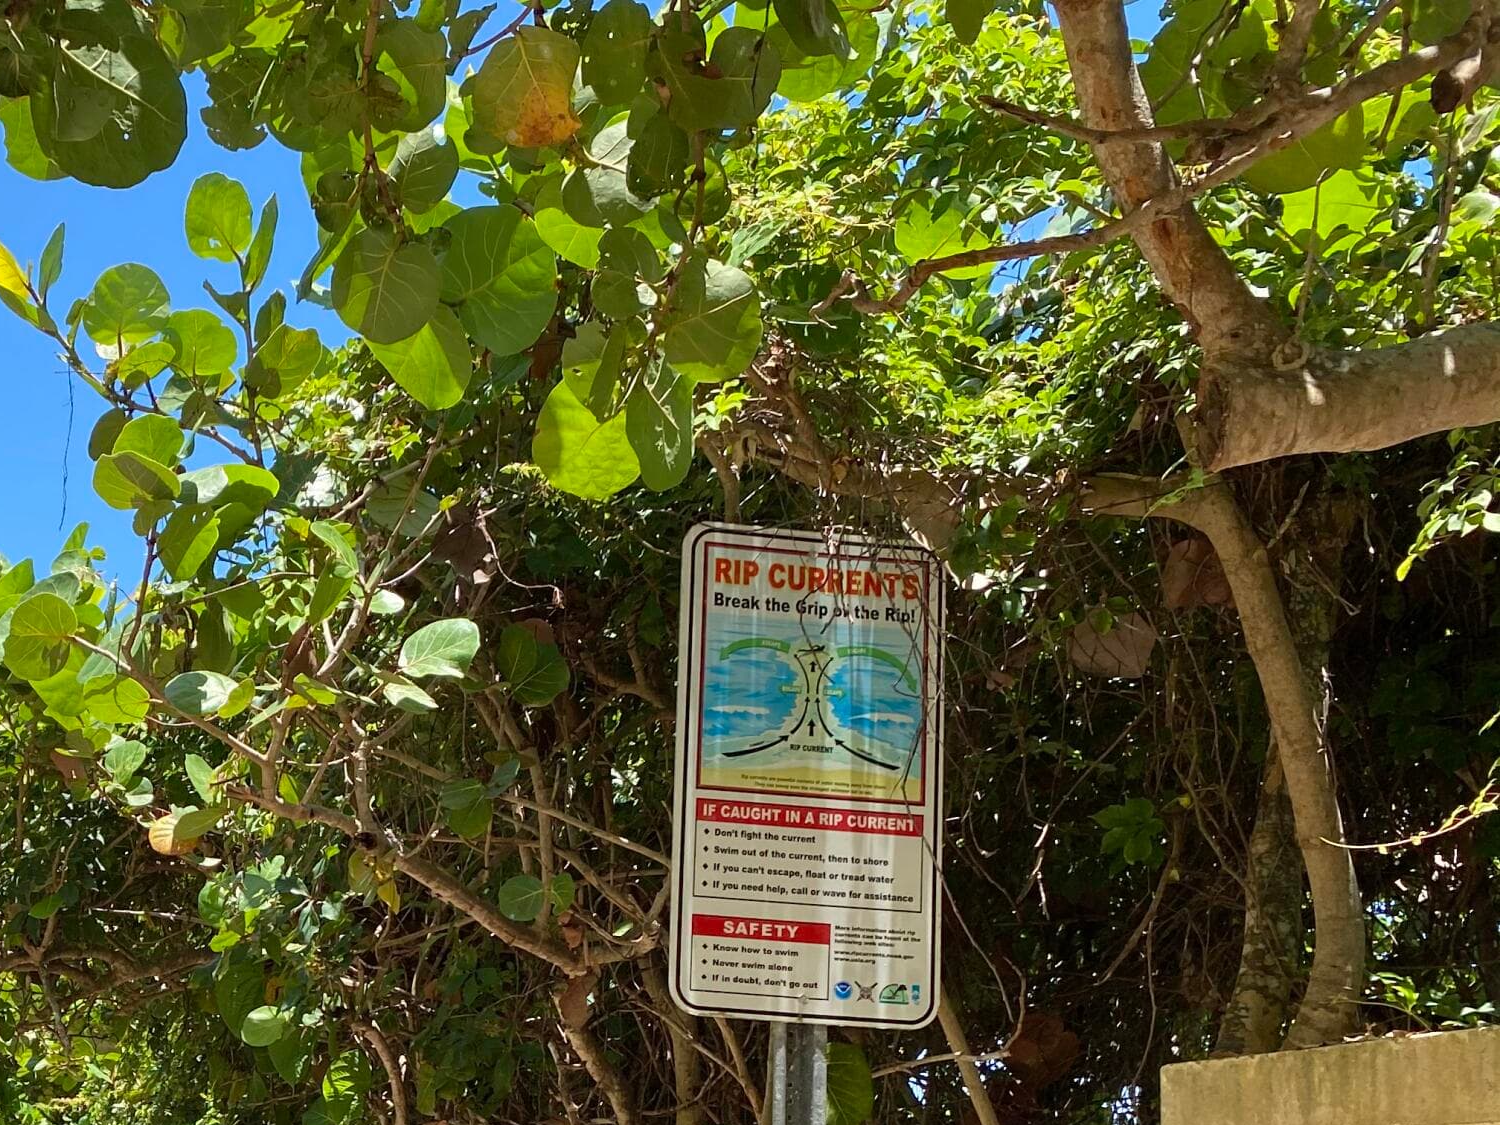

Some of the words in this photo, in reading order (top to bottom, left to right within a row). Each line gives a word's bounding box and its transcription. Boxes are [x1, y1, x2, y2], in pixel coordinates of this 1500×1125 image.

[714, 556, 759, 587] RIP
[768, 562, 920, 604] CURRENTS
[714, 591, 760, 610] Break
[766, 597, 790, 613] the
[796, 599, 828, 619] Grip
[854, 605, 879, 621] the
[885, 606, 915, 625] Rip!
[790, 743, 801, 751] RIP
[802, 744, 834, 754] CURRENT
[703, 804, 716, 817] IF
[720, 804, 781, 822] CAUGHT
[785, 810, 800, 823] IN
[804, 812, 815, 824] A
[819, 813, 843, 827] RIP
[847, 814, 914, 833] CURRENT
[714, 828, 738, 838] Don't
[741, 830, 762, 842] fight
[764, 832, 780, 841] the
[782, 834, 816, 845] current
[713, 845, 739, 855] Swim
[742, 847, 757, 857] out
[759, 849, 769, 858] of
[771, 850, 786, 859] the
[788, 852, 826, 864] current,
[828, 855, 848, 864] then
[851, 857, 860, 865] to
[863, 857, 889, 867] shore
[713, 863, 721, 871] If
[723, 865, 739, 874] you
[741, 865, 765, 874] can't
[767, 868, 803, 880] escape,
[805, 870, 826, 879] float
[829, 873, 839, 881] or
[841, 873, 865, 882] tread
[868, 875, 895, 885] water
[712, 880, 720, 888] If
[722, 882, 739, 892] you
[741, 882, 764, 892] need
[766, 884, 788, 895] help,
[791, 886, 808, 895] call
[822, 890, 846, 898] wave
[849, 891, 861, 899] for
[864, 891, 914, 903] assistance
[723, 920, 799, 940] SAFETY
[713, 944, 739, 953] Know
[741, 946, 761, 954] how
[775, 949, 799, 957] swim
[712, 959, 739, 968] Never
[742, 961, 765, 970] swim
[768, 963, 793, 972] alone
[712, 974, 719, 982] If
[722, 975, 730, 983] in
[733, 975, 761, 986] doubt,
[764, 978, 786, 987] don't
[789, 982, 800, 990] go
[803, 981, 818, 989] out
